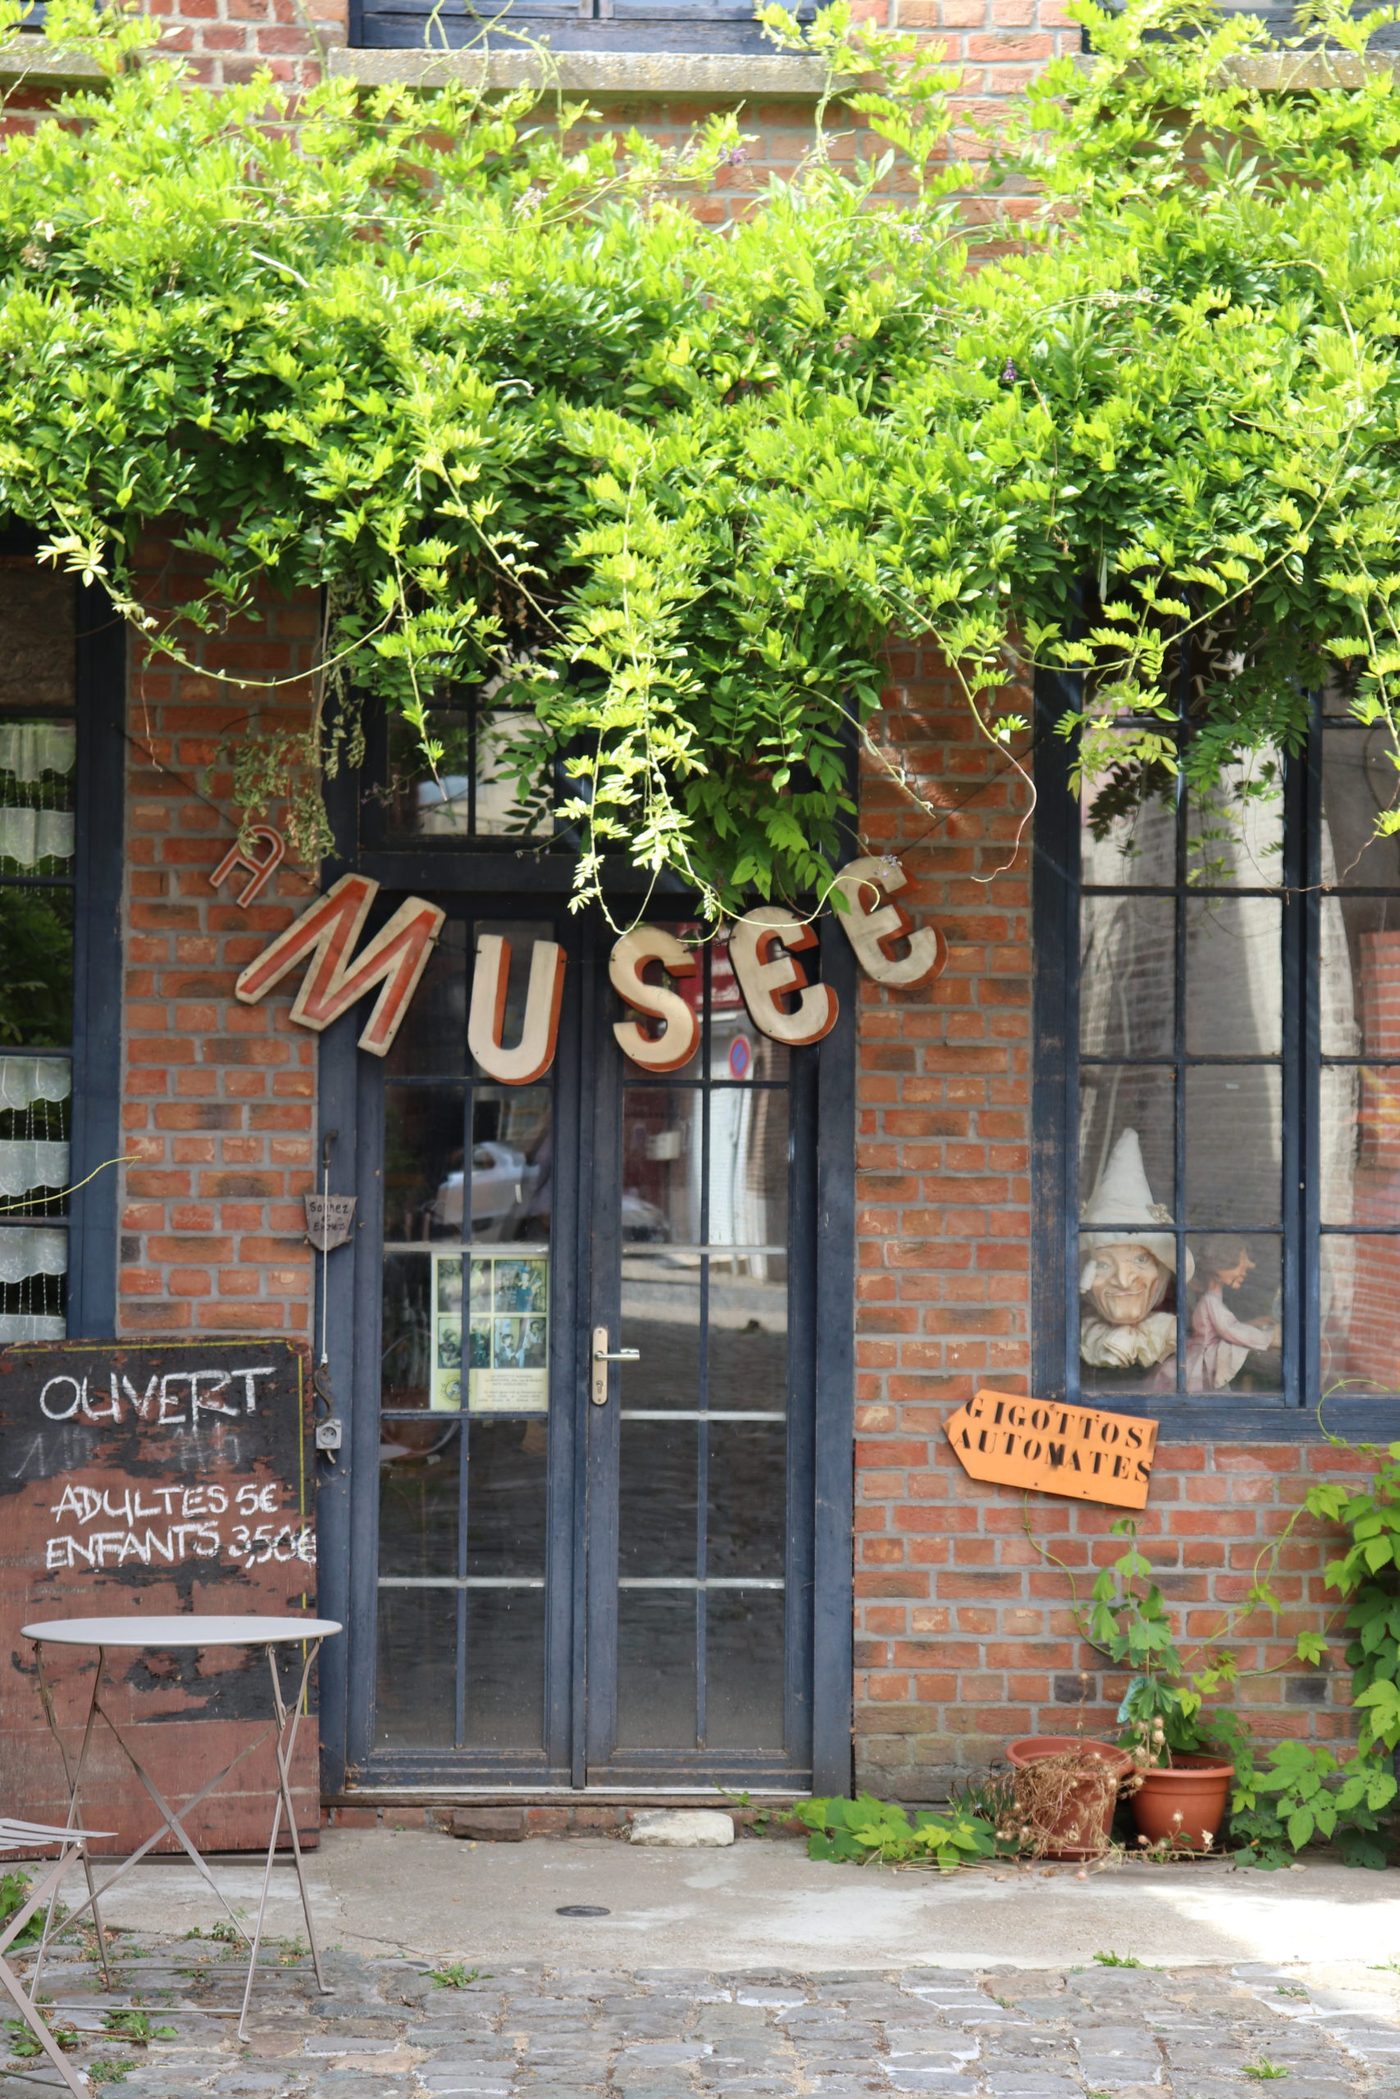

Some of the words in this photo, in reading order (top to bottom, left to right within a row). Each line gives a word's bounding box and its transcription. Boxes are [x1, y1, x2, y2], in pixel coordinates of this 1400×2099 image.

[40, 1366, 277, 1425] OUVERT
[965, 1397, 1144, 1450] GIGOTTOS
[954, 1427, 1152, 1484] AUTOMATES
[51, 1484, 228, 1527] ADULTES
[235, 1483, 279, 1516] 5€
[46, 1521, 220, 1570] ENFANTS
[228, 1525, 317, 1569] 3,50€
